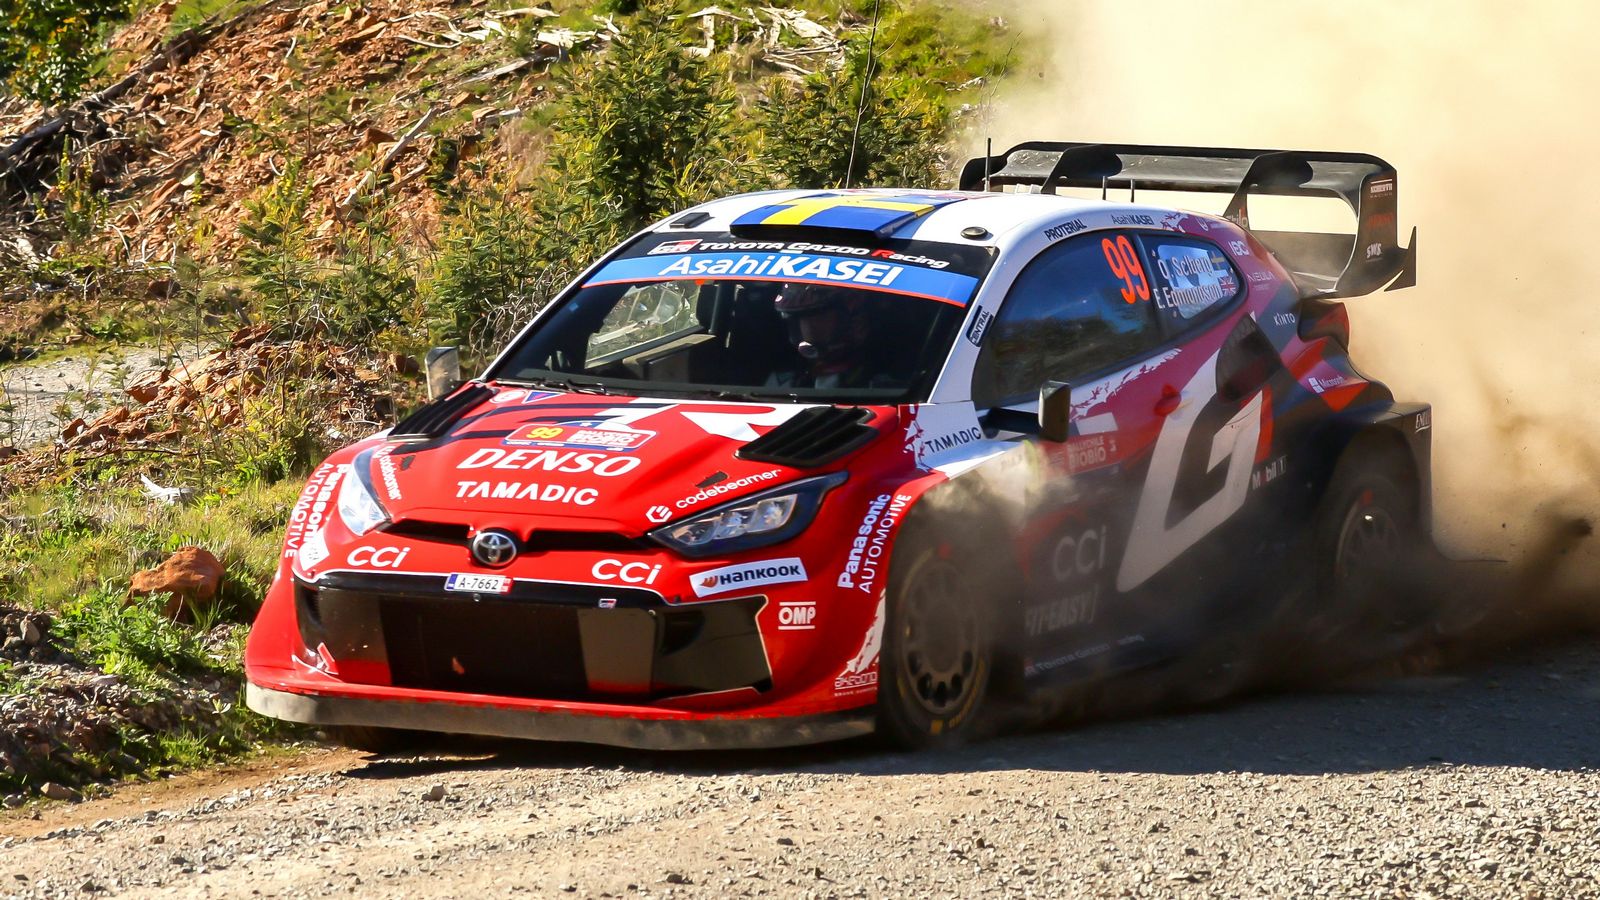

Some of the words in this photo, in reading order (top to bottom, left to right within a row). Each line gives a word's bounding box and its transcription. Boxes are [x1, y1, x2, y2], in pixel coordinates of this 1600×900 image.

[1044, 218, 1088, 241] PROTERIAL
[699, 241, 786, 251] TOYOTA
[870, 249, 950, 269] Racing
[658, 255, 904, 287] AsahiKASEI
[1101, 235, 1151, 304] 99
[526, 426, 564, 438] 99
[925, 426, 982, 453] TAMADIC
[457, 448, 641, 478] DENSO
[457, 481, 599, 505] TAMADIC
[676, 470, 782, 509] codebeamer
[285, 463, 334, 558] AUTOMOTIVE
[837, 494, 891, 588] Panasonic
[858, 494, 912, 594] AUTOMOTIVE
[347, 546, 411, 568] CCi
[458, 577, 499, 590] A-7662
[591, 559, 663, 584] CCi
[778, 606, 816, 625] OMP
